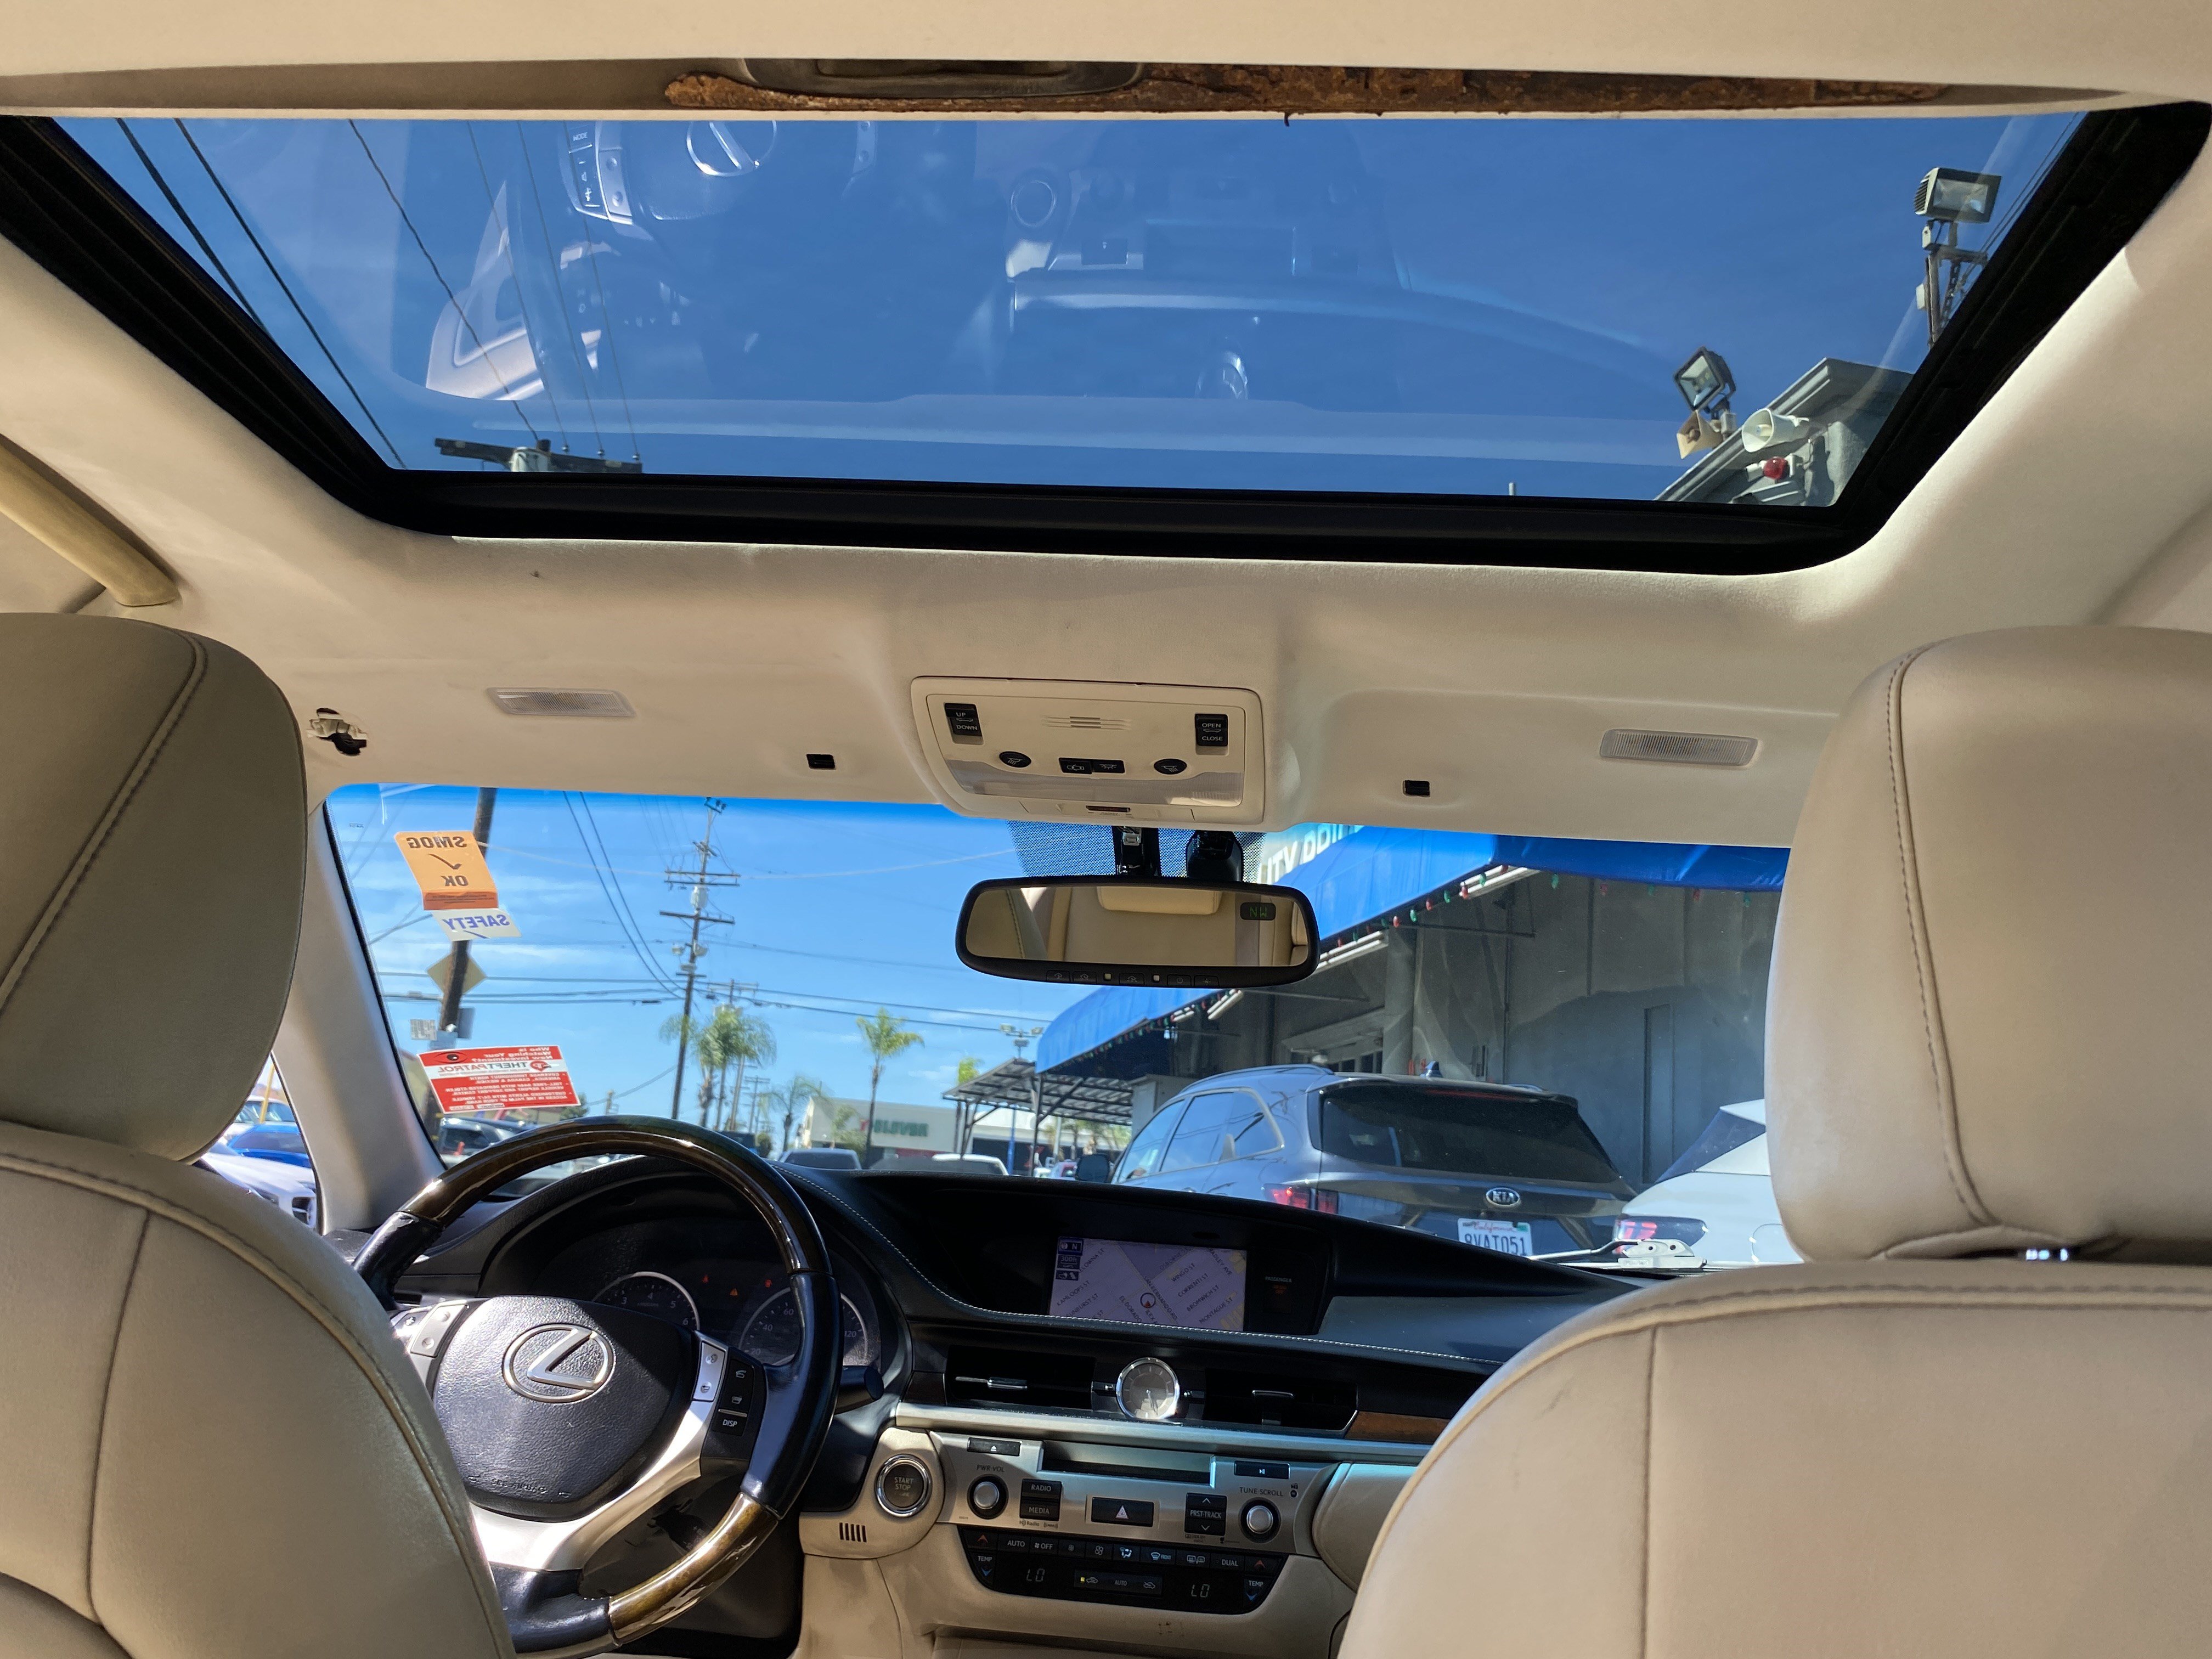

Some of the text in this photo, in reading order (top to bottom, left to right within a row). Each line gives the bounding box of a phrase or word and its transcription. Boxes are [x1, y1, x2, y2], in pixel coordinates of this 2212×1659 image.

[1250, 906, 1267, 917] NW
[1492, 1190, 1515, 1203] KIA
[1171, 1268, 1189, 1282] WINGO
[1057, 1285, 1084, 1306] KAMLOOPS
[1186, 1290, 1214, 1312] BROMWICH
[1199, 1302, 1227, 1324] MONTAGUE
